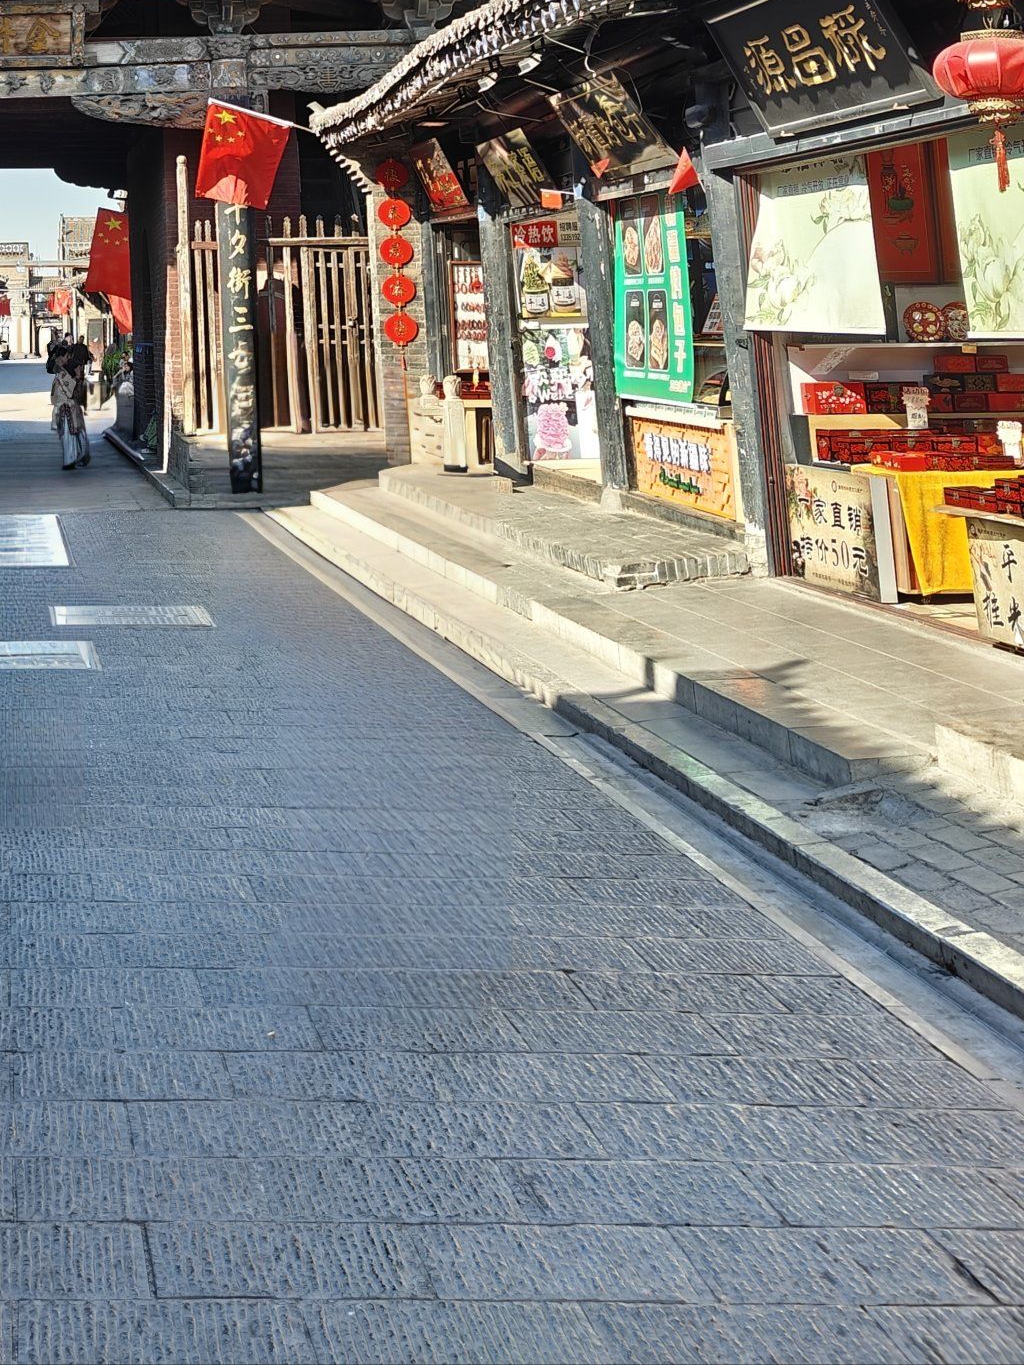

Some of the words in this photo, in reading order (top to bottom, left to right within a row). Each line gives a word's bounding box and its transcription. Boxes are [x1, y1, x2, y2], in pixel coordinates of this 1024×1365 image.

[514, 225, 555, 244] 冷热饮
[797, 496, 862, 537] 厂家直销
